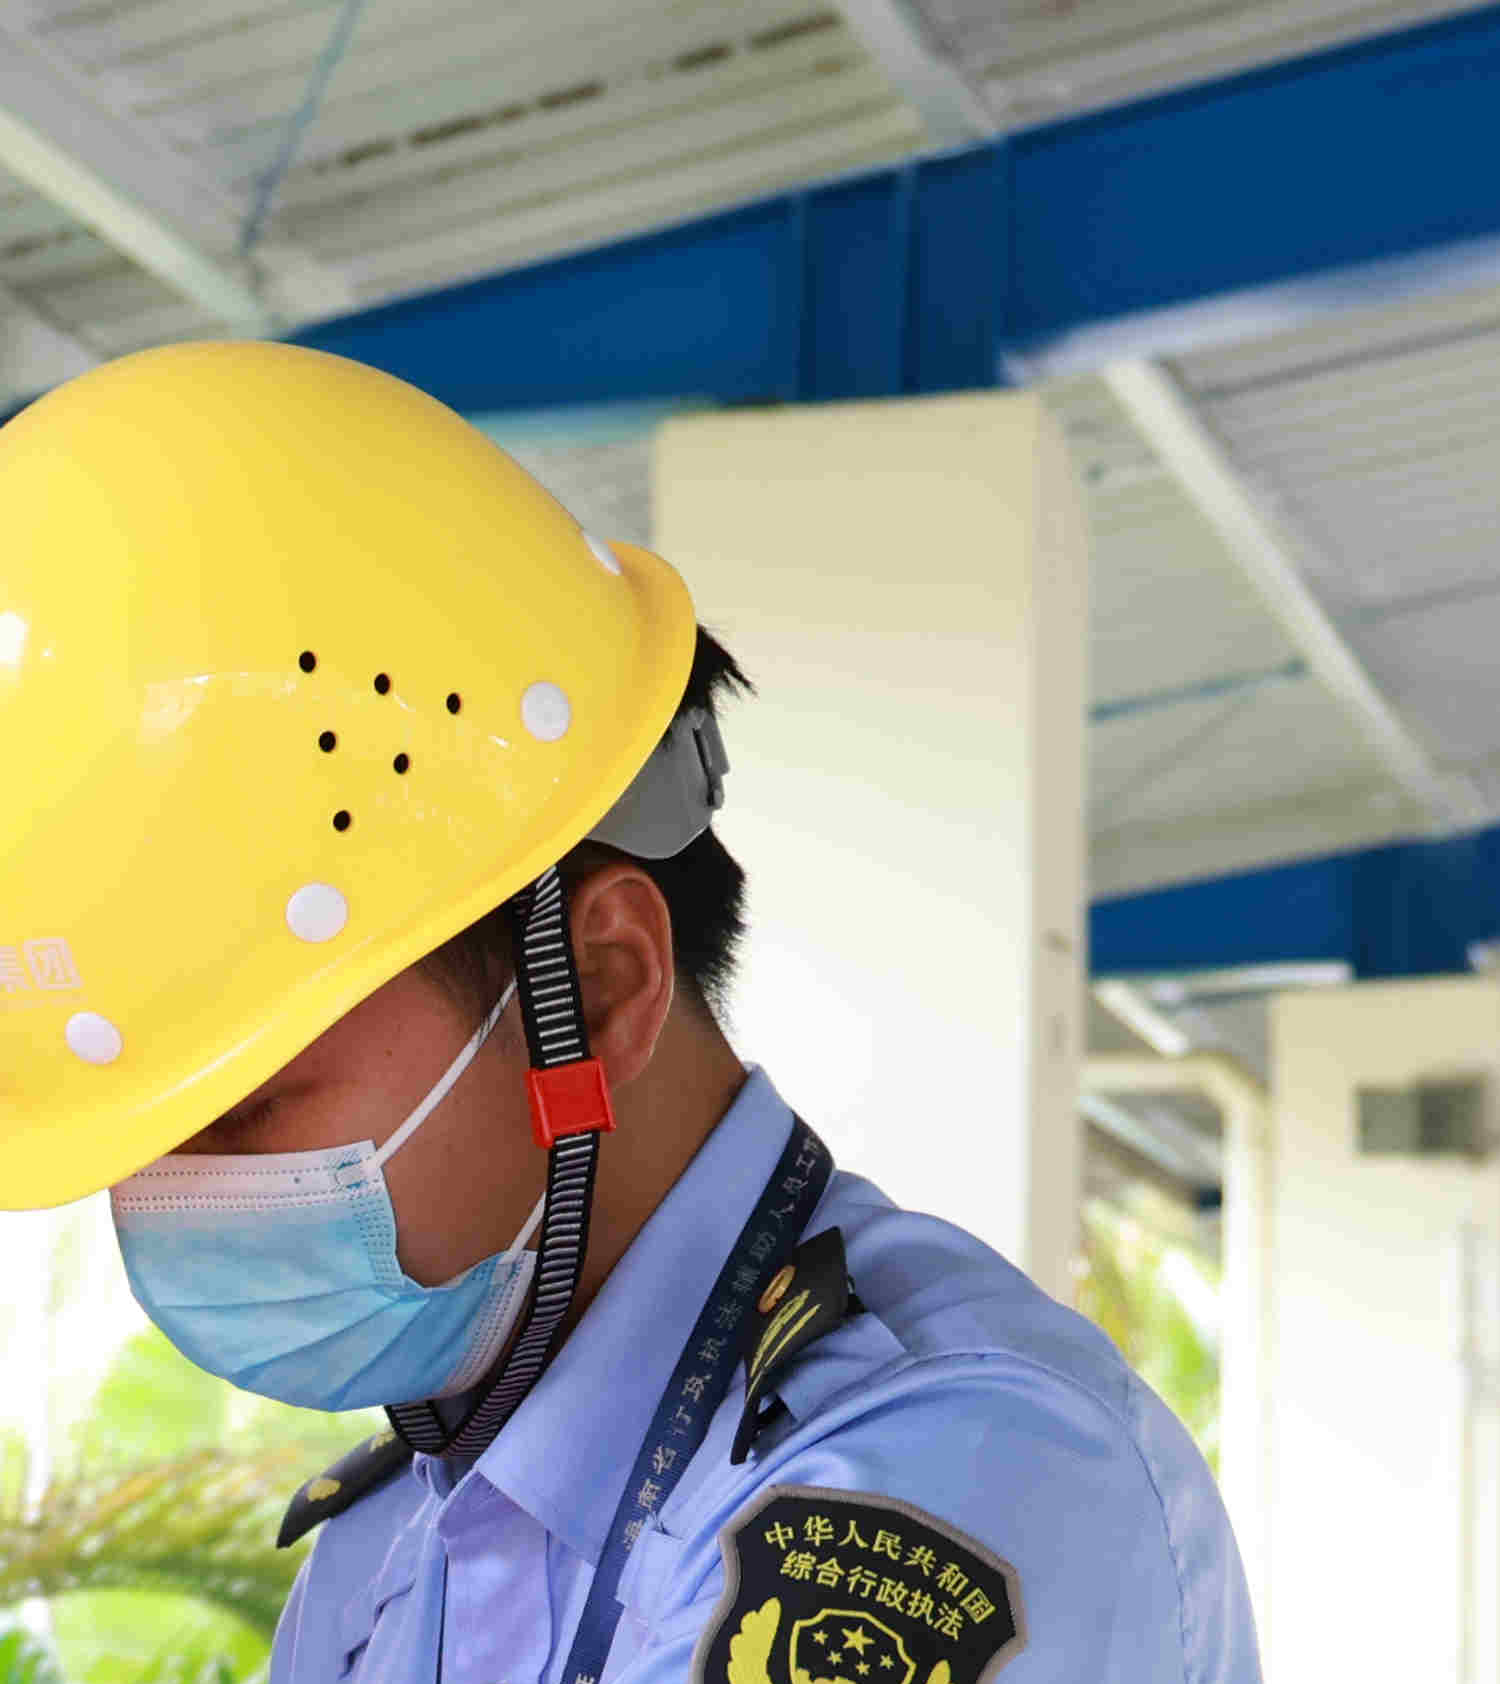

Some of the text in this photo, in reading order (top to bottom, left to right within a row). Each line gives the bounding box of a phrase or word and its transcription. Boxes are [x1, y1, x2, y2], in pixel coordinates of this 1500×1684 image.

[764, 1515, 996, 1624] 中华人民共和国
[779, 1549, 964, 1640] 综合行政执法
